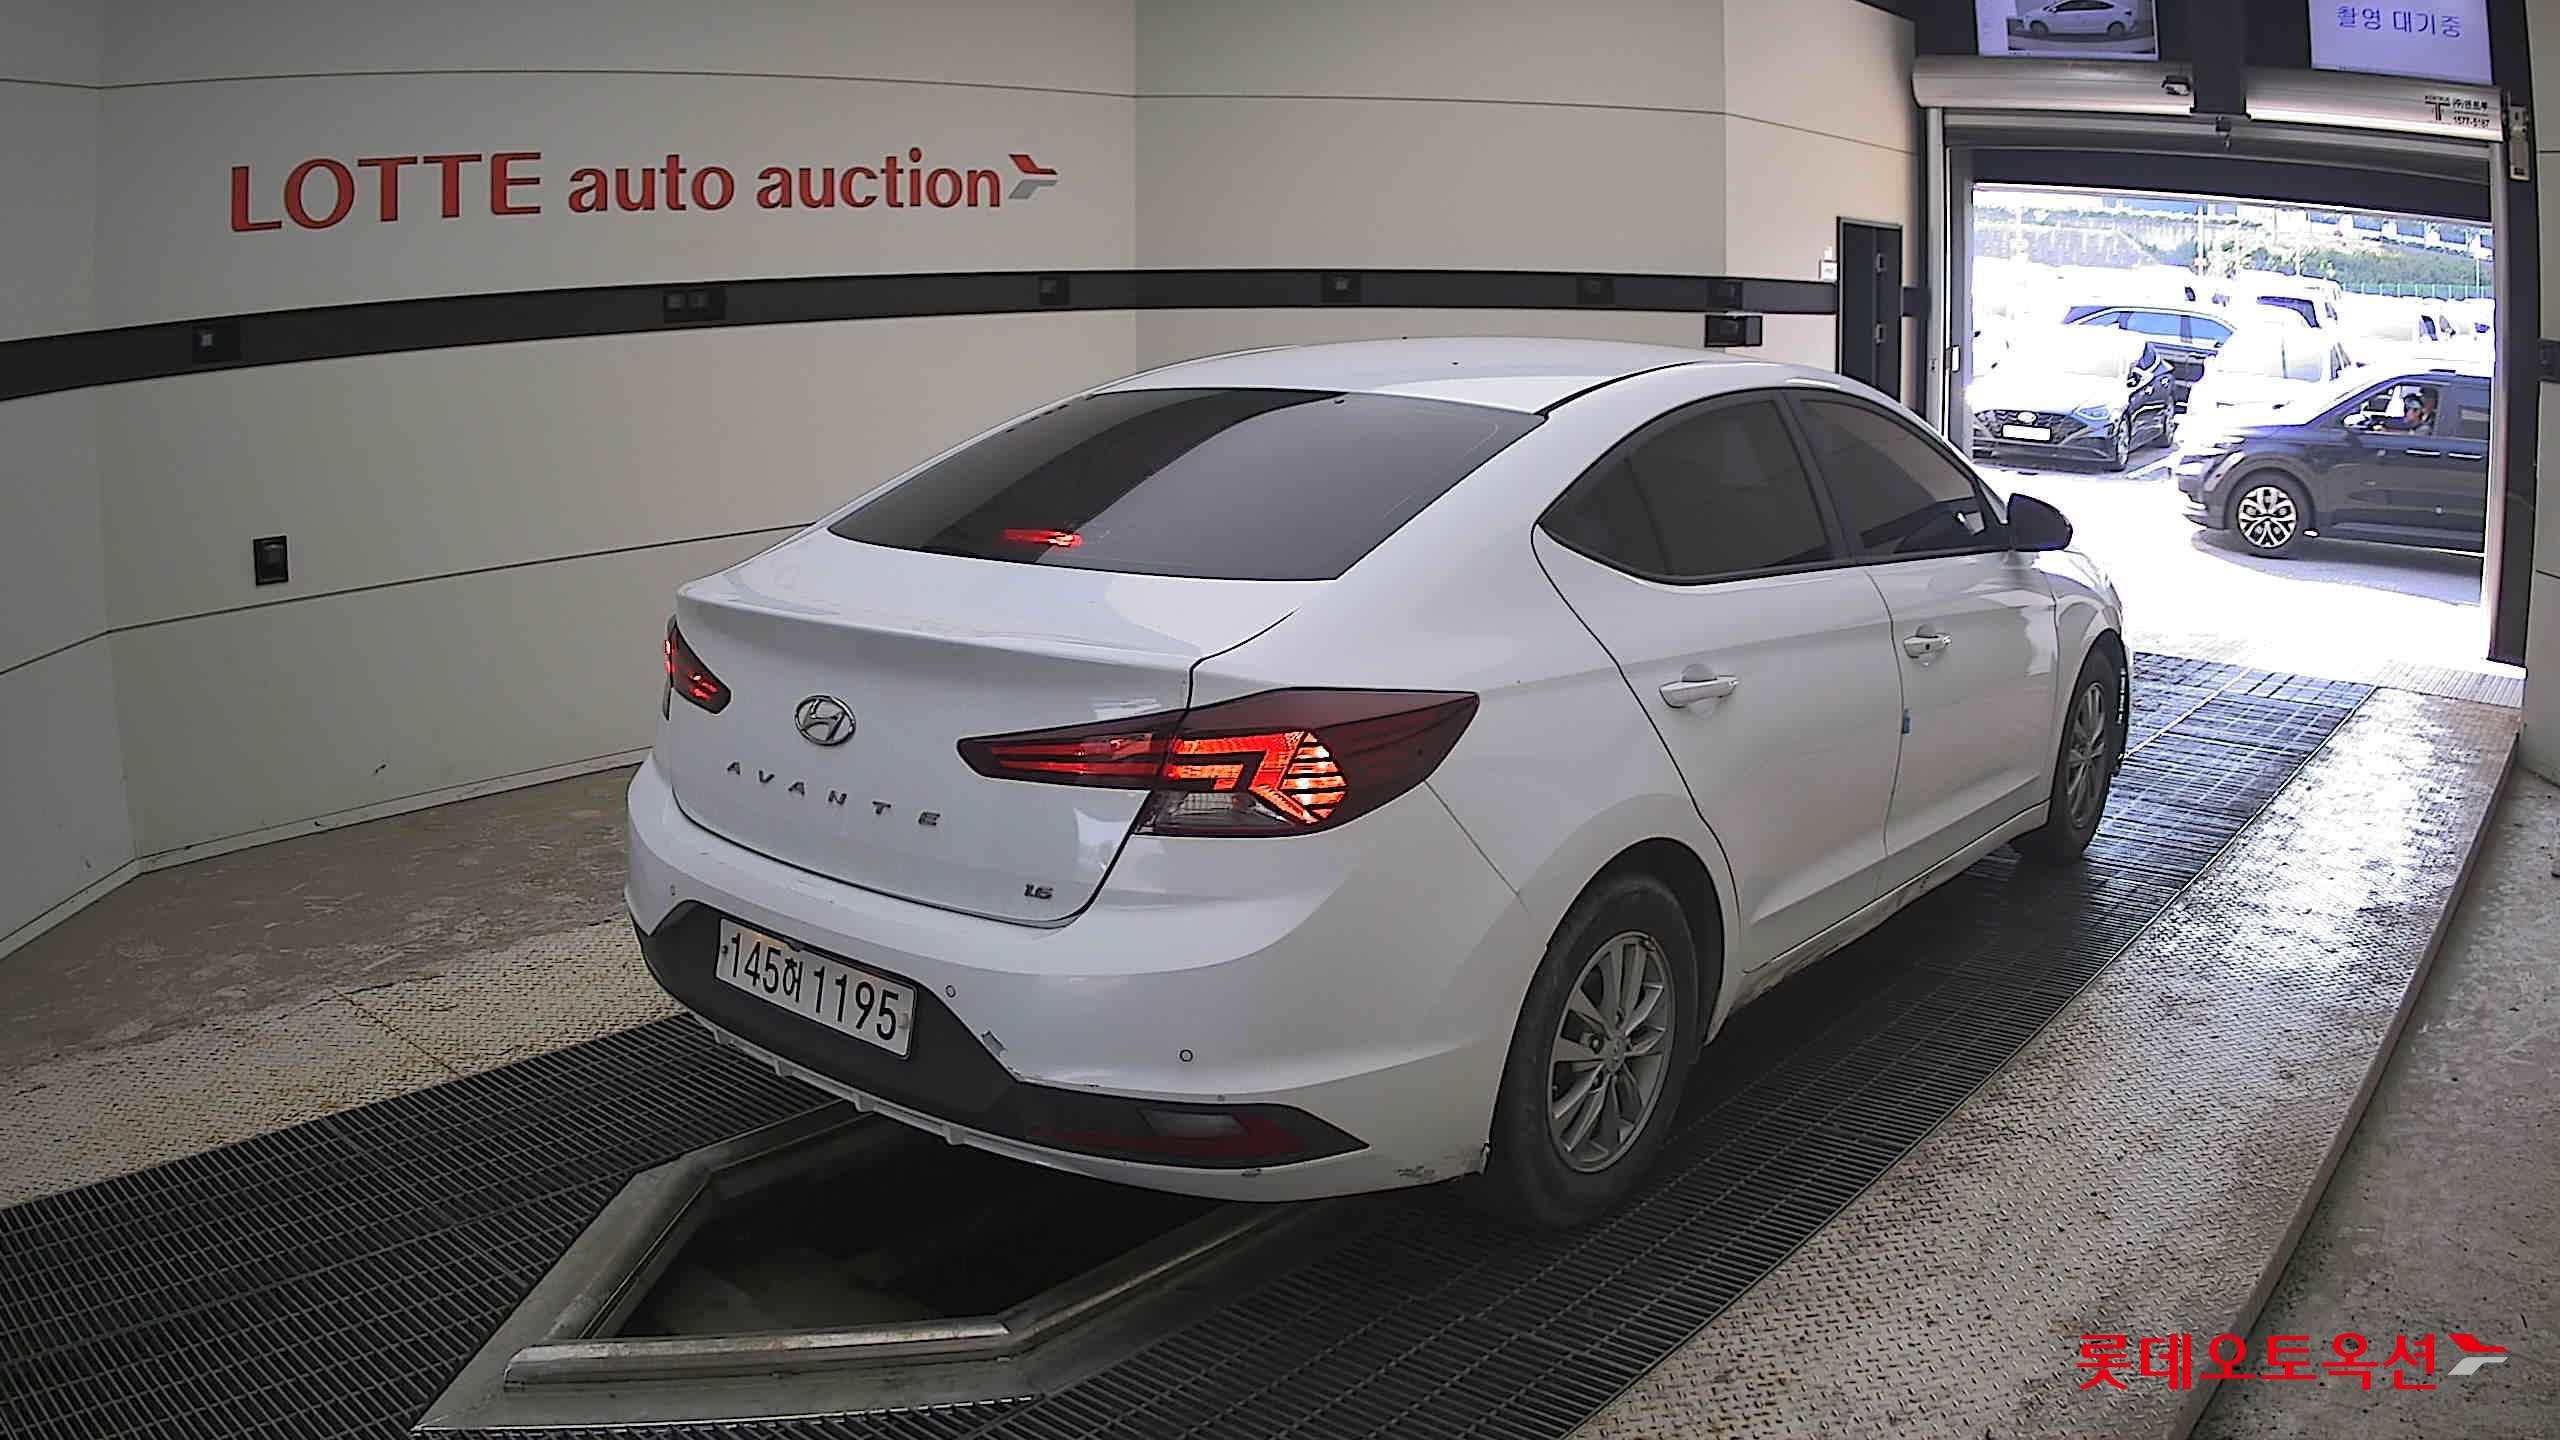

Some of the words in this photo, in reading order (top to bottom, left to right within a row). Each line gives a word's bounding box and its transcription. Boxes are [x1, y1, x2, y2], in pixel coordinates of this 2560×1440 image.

[2337, 6, 2383, 31] 촬영
[2392, 10, 2461, 39] 대기중
[230, 152, 542, 232] LOTTE
[569, 153, 736, 212] auto
[757, 148, 1002, 209] auction
[726, 760, 941, 827] AVANTE
